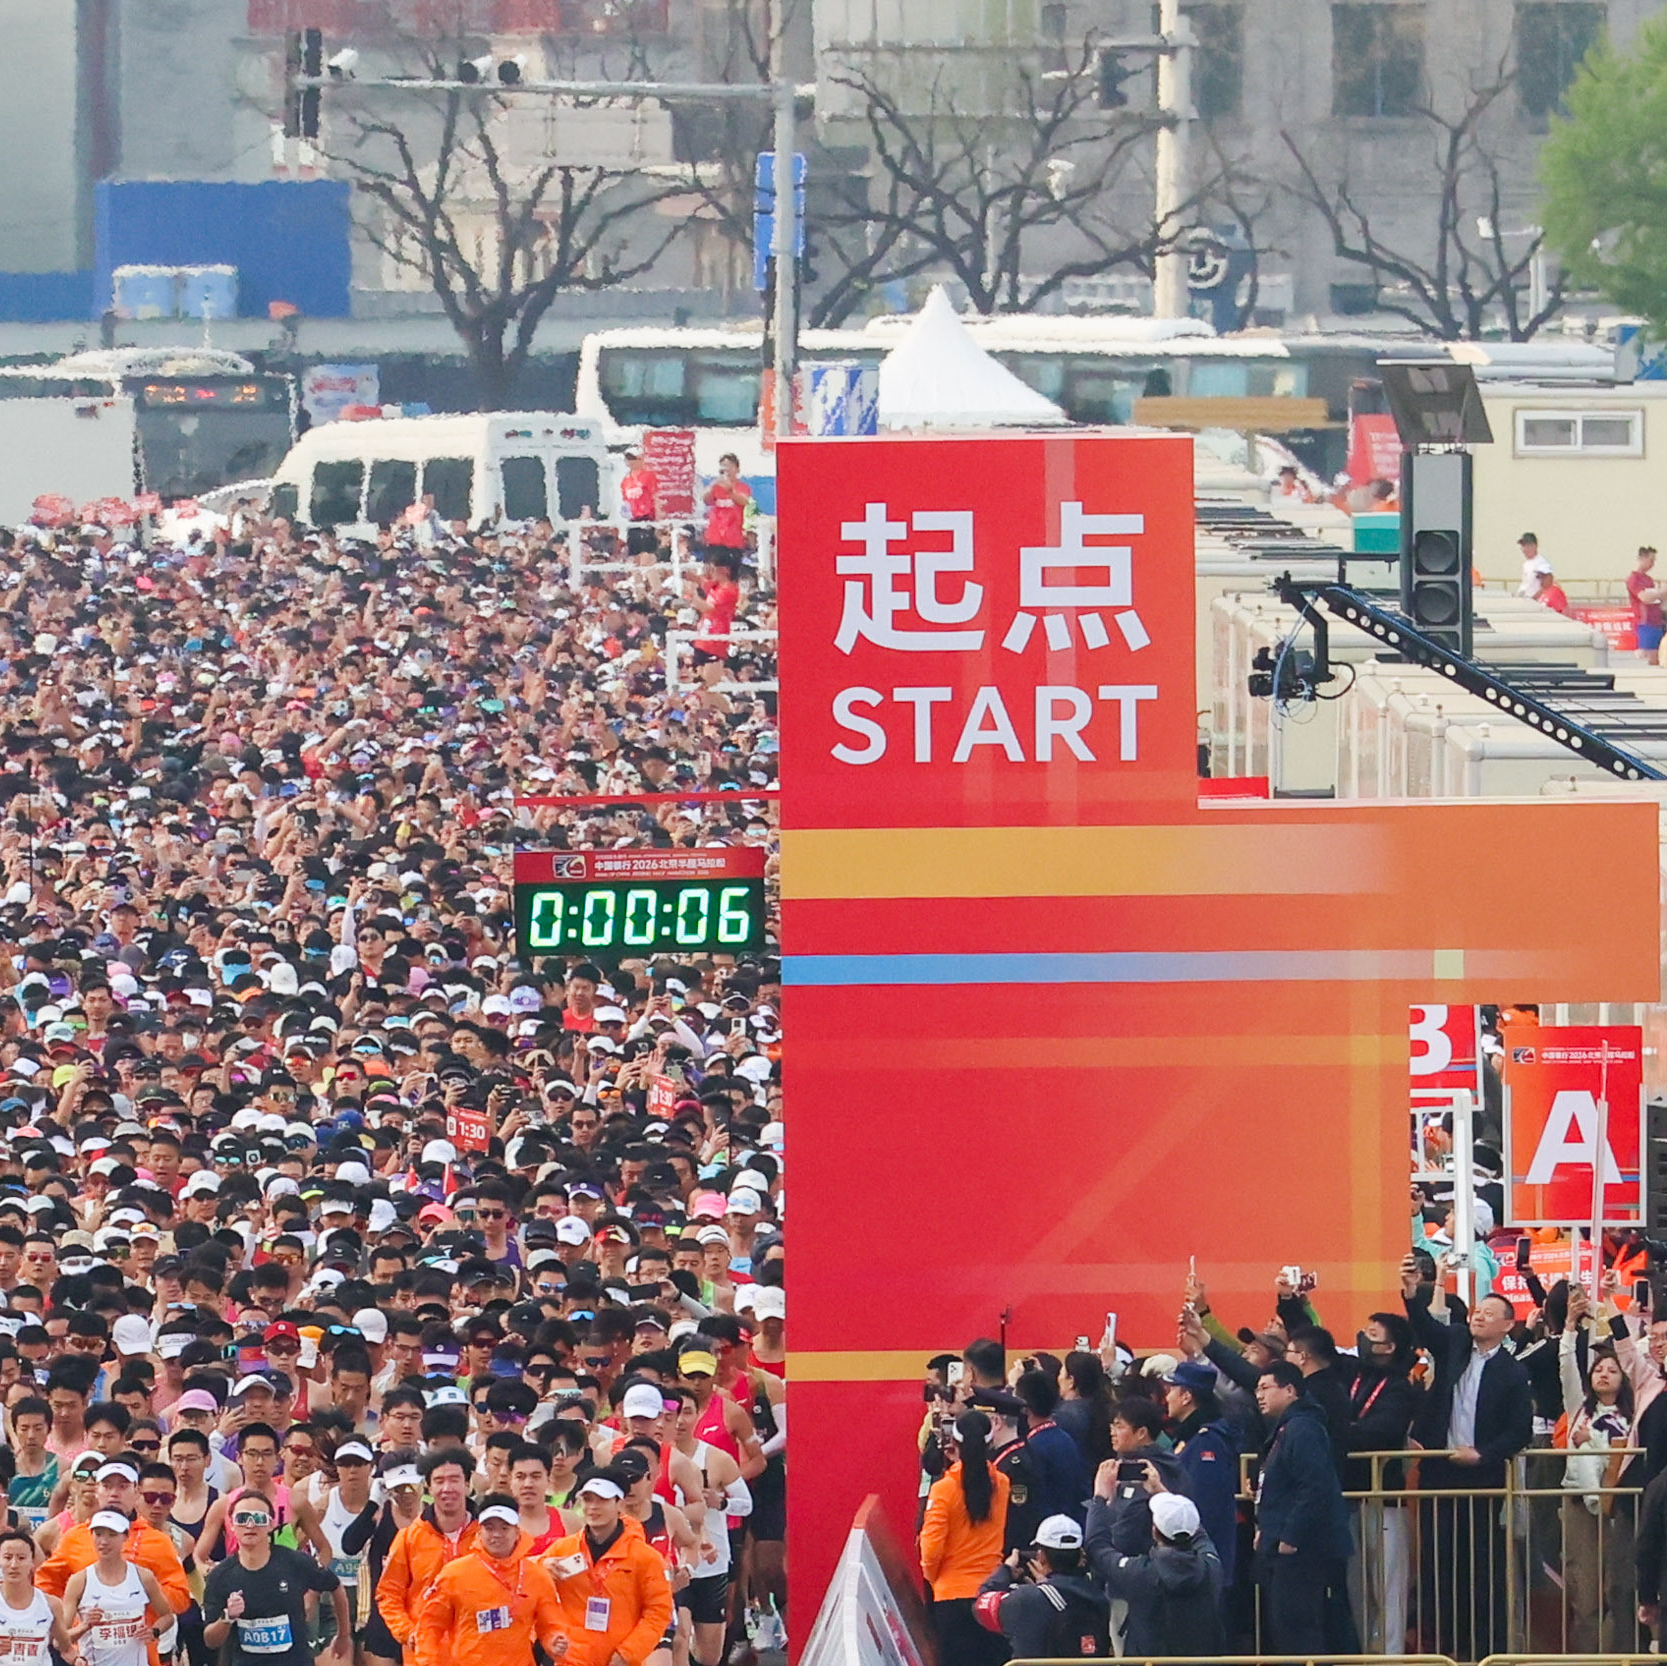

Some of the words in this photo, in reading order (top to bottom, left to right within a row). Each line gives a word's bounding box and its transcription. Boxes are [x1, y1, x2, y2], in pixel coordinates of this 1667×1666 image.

[834, 499, 1152, 654] 起点
[830, 683, 1158, 766] START
[529, 887, 751, 948] 0:00:06
[1409, 1004, 1453, 1076] B
[458, 1121, 486, 1140] 1:30
[1525, 1090, 1624, 1184] A
[243, 1626, 286, 1646] A0817
